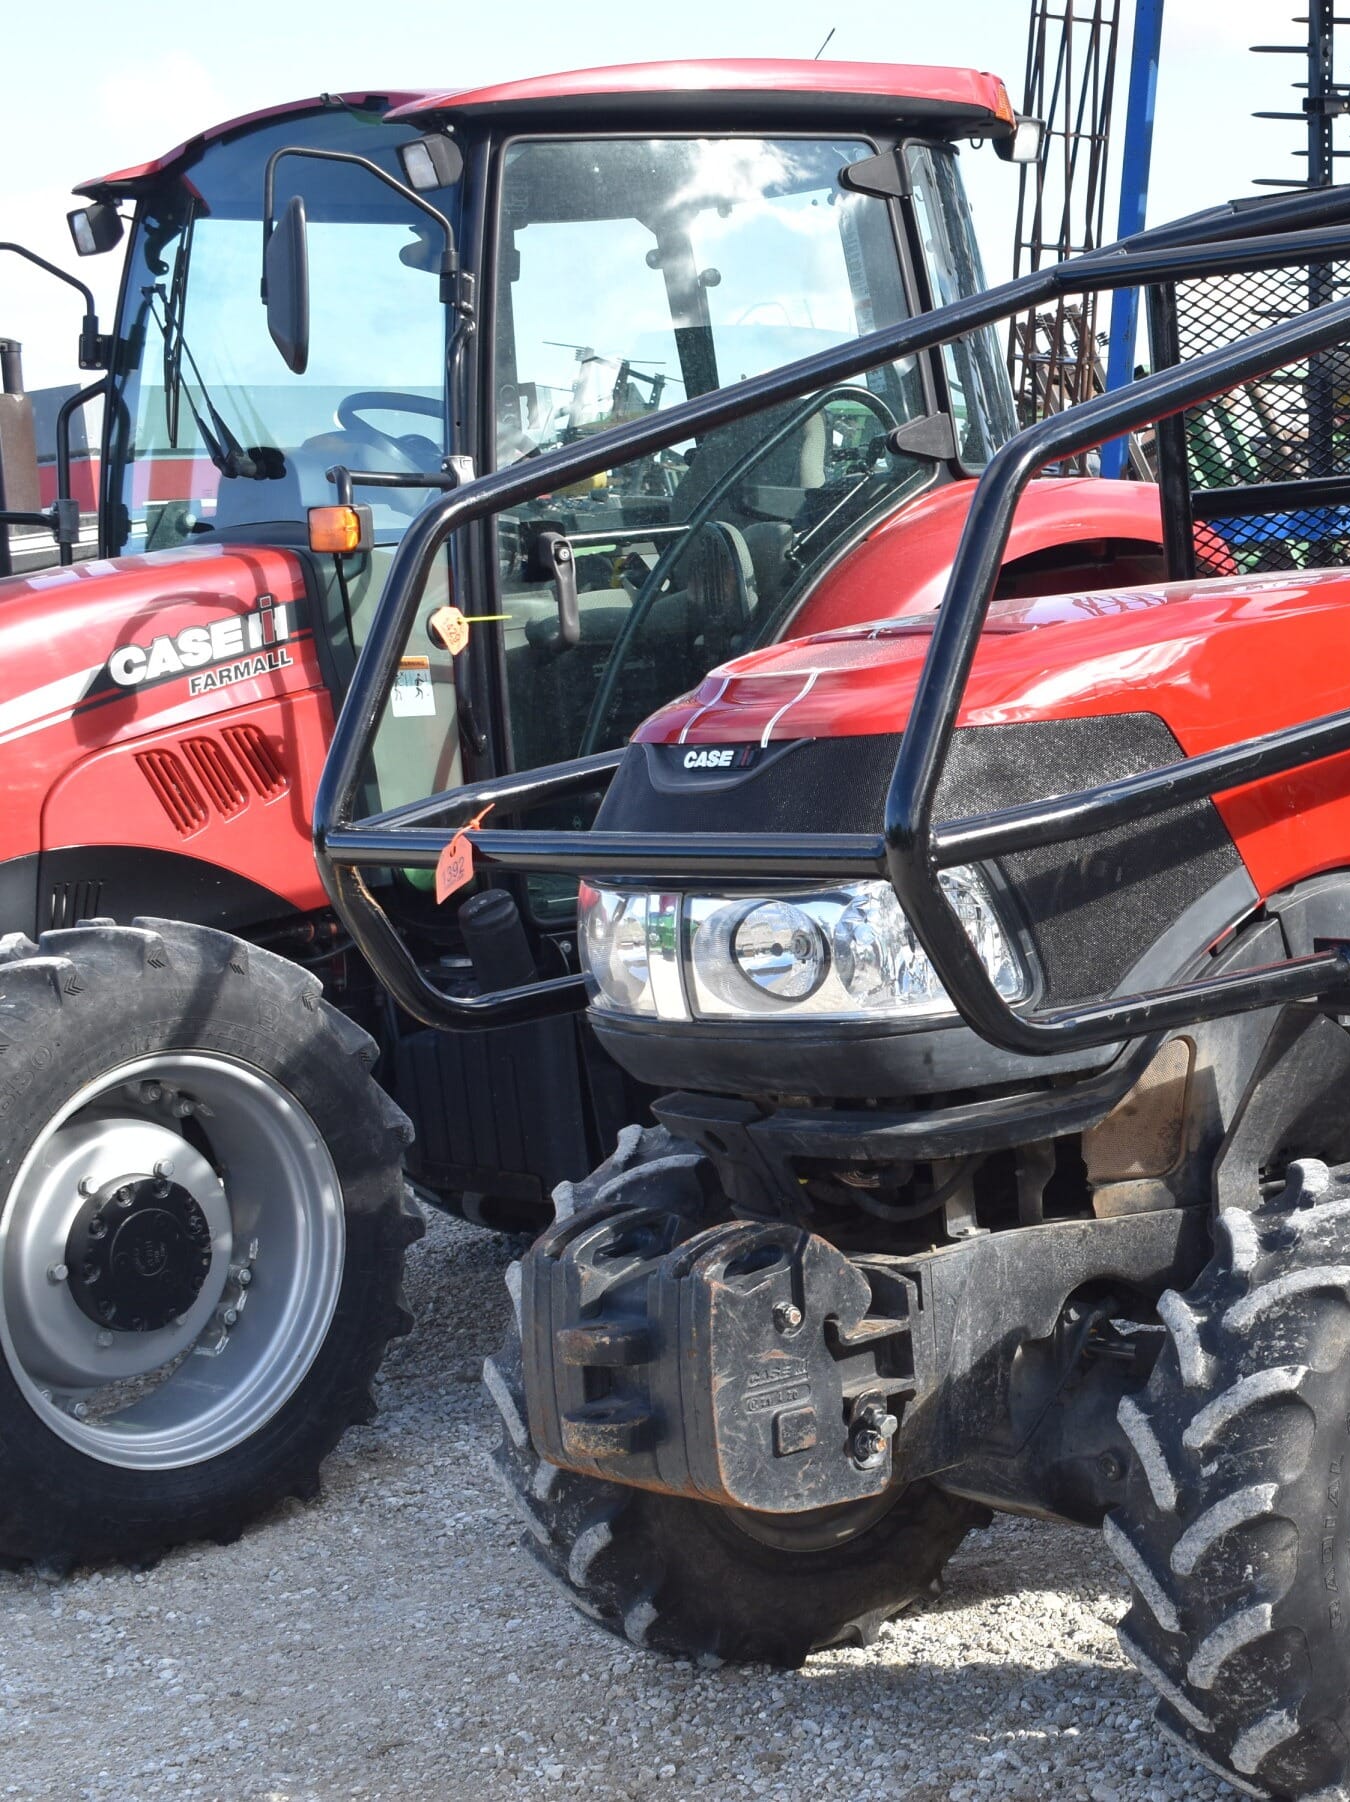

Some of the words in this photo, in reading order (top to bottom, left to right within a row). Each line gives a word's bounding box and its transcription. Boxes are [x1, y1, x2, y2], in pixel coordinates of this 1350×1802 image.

[109, 616, 245, 687] CASE
[189, 647, 294, 697] FARMALL
[683, 749, 735, 769] CASE
